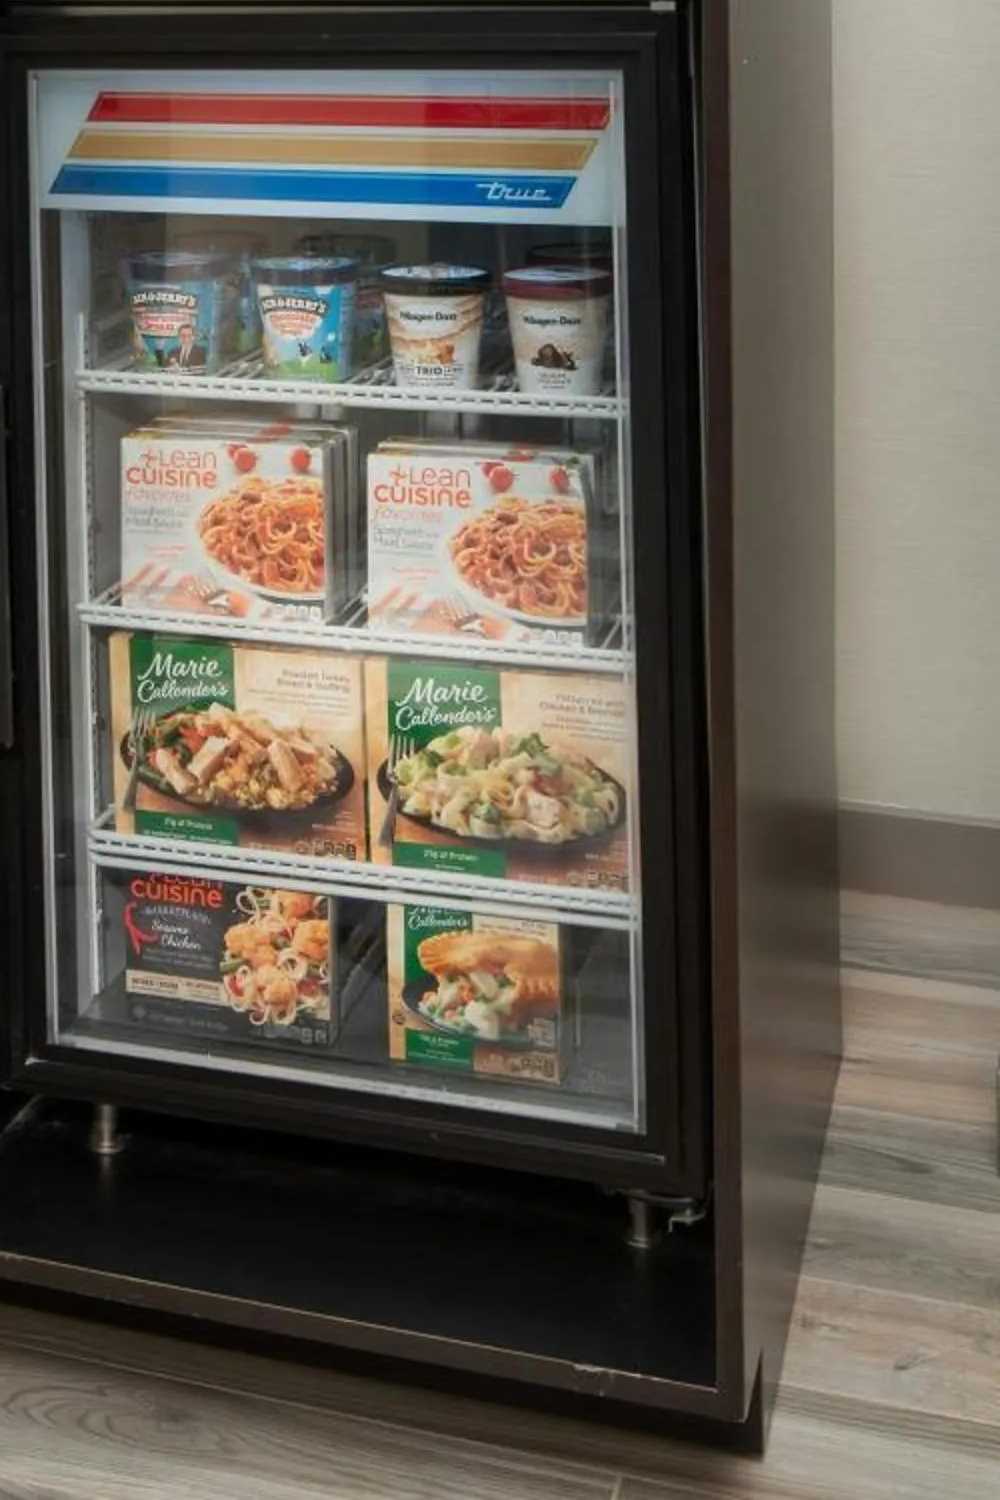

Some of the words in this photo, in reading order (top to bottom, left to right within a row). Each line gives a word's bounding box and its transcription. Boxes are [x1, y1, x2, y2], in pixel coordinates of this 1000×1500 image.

[476, 181, 552, 200] True
[138, 652, 223, 681] Marie
[137, 679, 228, 702] Callender's
[396, 678, 488, 706] Marie
[395, 705, 496, 731] Callender's
